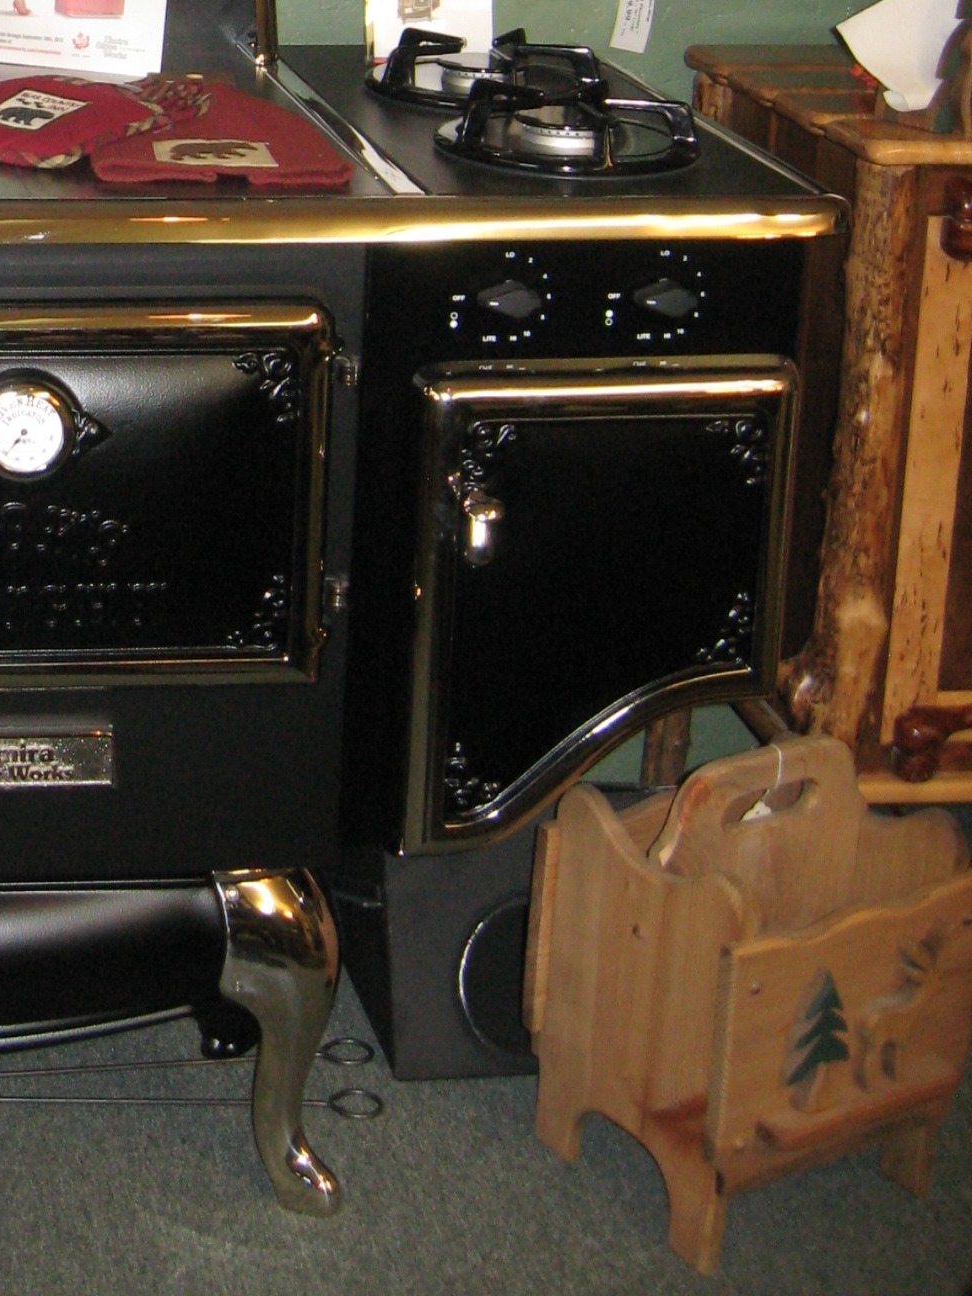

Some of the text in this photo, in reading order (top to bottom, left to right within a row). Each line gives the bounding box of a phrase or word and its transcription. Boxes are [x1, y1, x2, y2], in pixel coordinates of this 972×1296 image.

[505, 251, 516, 259] LO
[660, 249, 671, 257] LO
[451, 294, 466, 302] OFF
[607, 292, 621, 300] OFF
[481, 334, 497, 343] LITE
[509, 335, 518, 343] HI
[636, 332, 651, 341] LITE
[663, 332, 672, 340] HI
[26, 394, 56, 418] HEAT
[7, 764, 75, 782] Works
